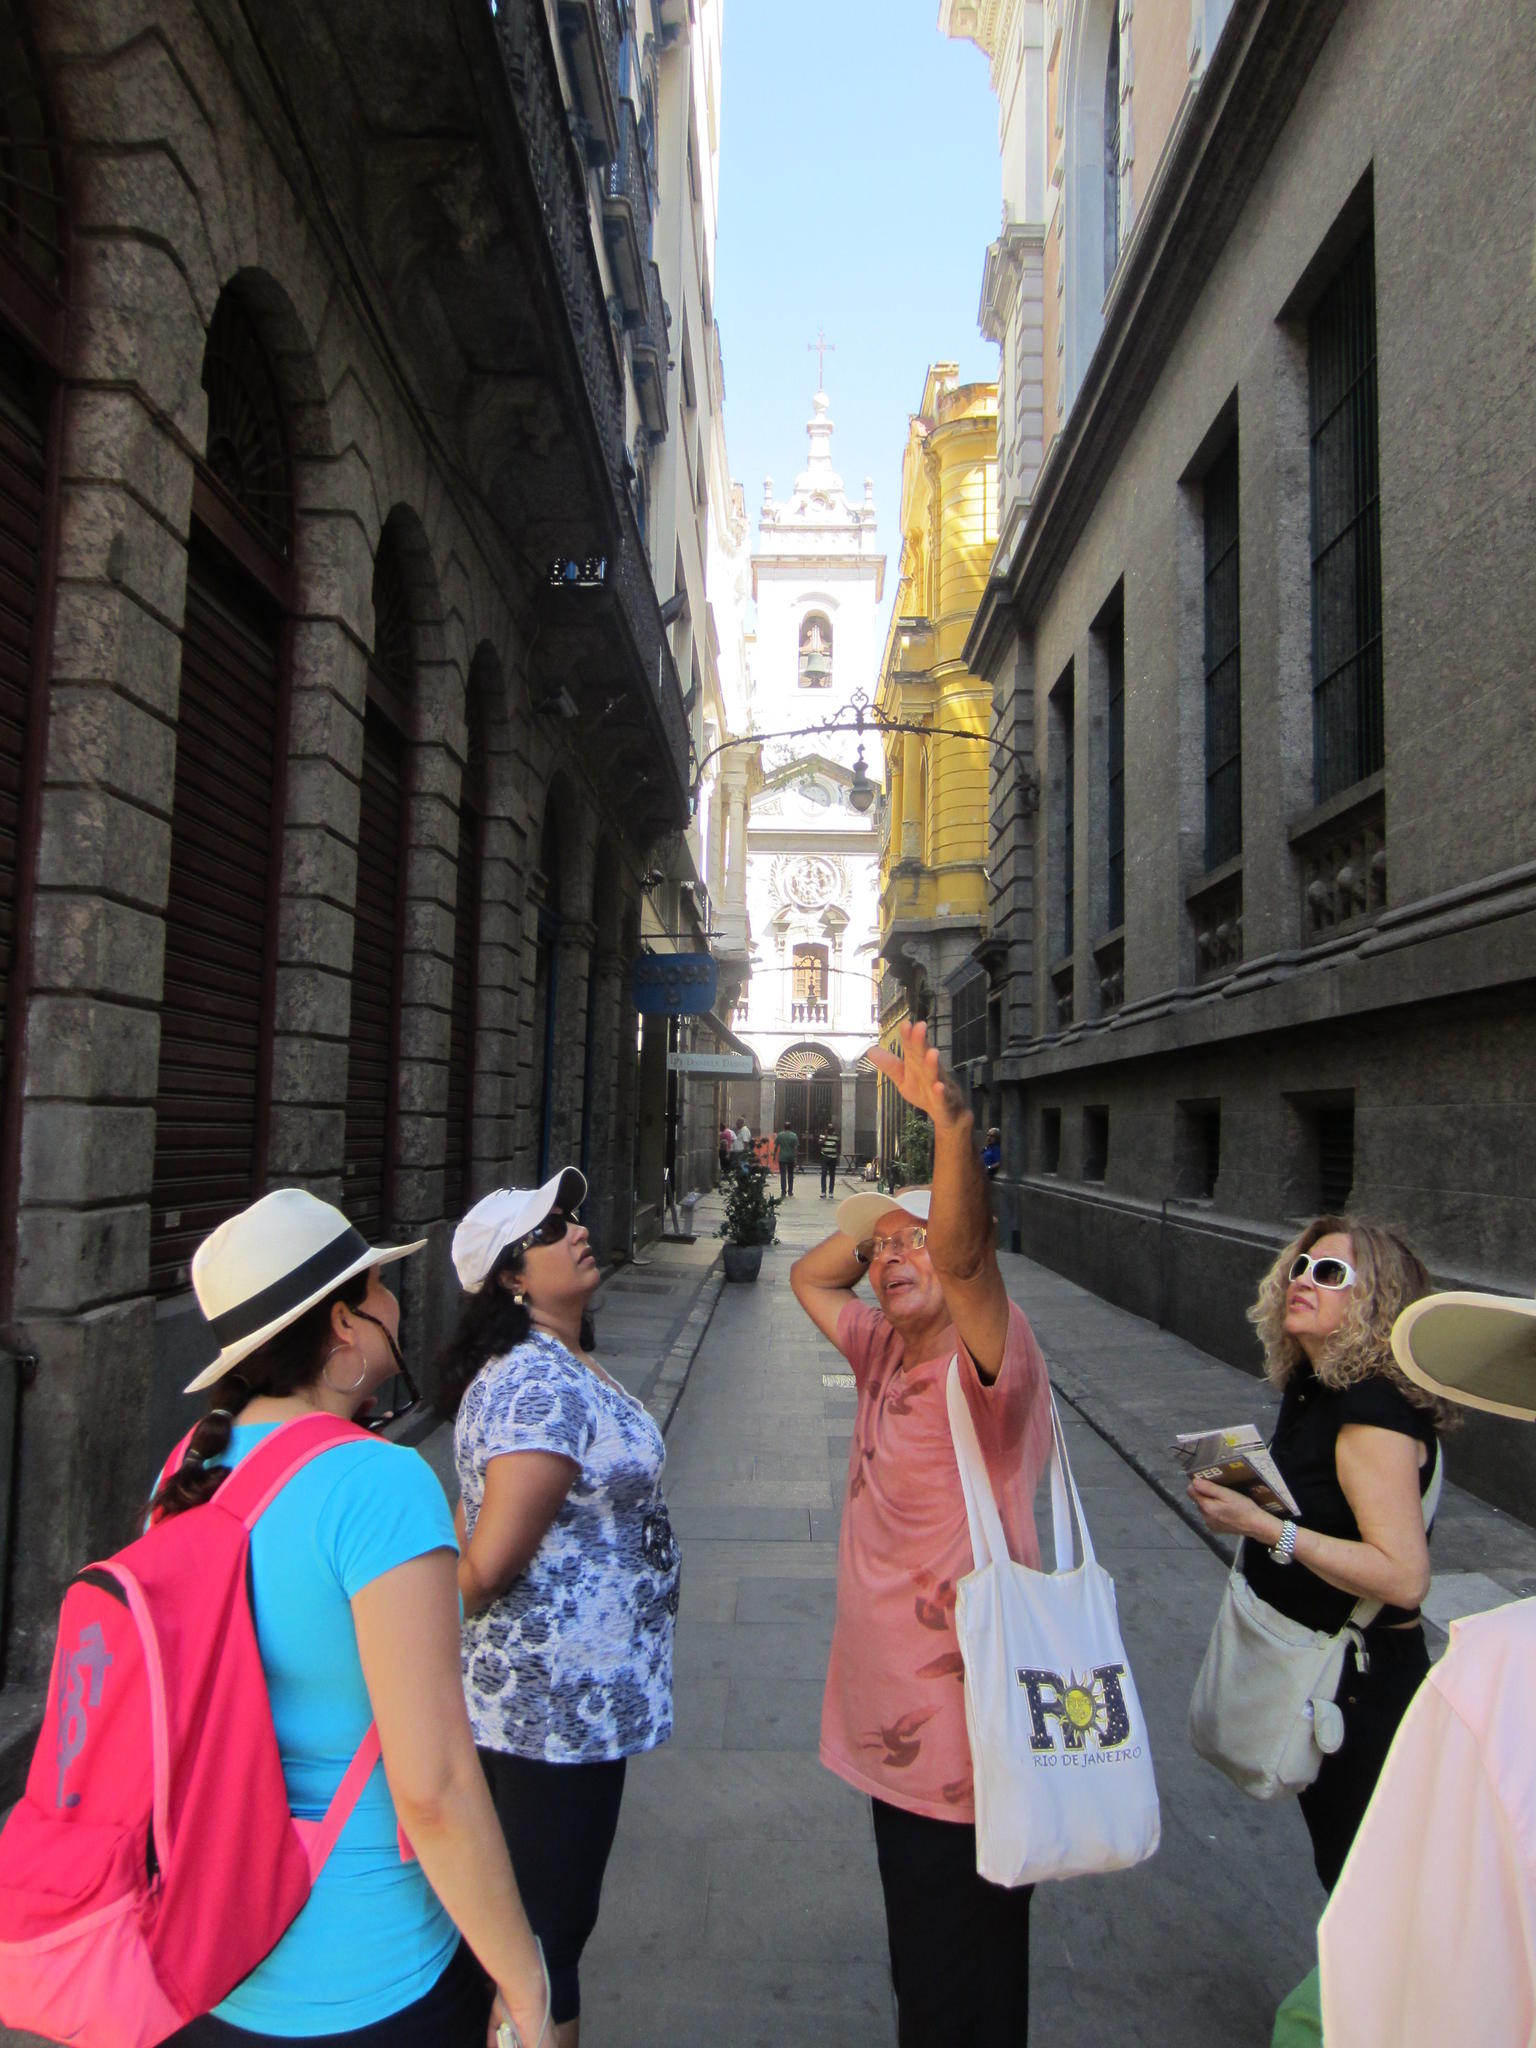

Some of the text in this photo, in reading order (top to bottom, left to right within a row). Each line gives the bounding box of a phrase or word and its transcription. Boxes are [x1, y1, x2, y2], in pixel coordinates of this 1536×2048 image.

[1193, 1467, 1224, 1479] FEB
[1032, 1746, 1142, 1768] RIO DE JANEIRO
